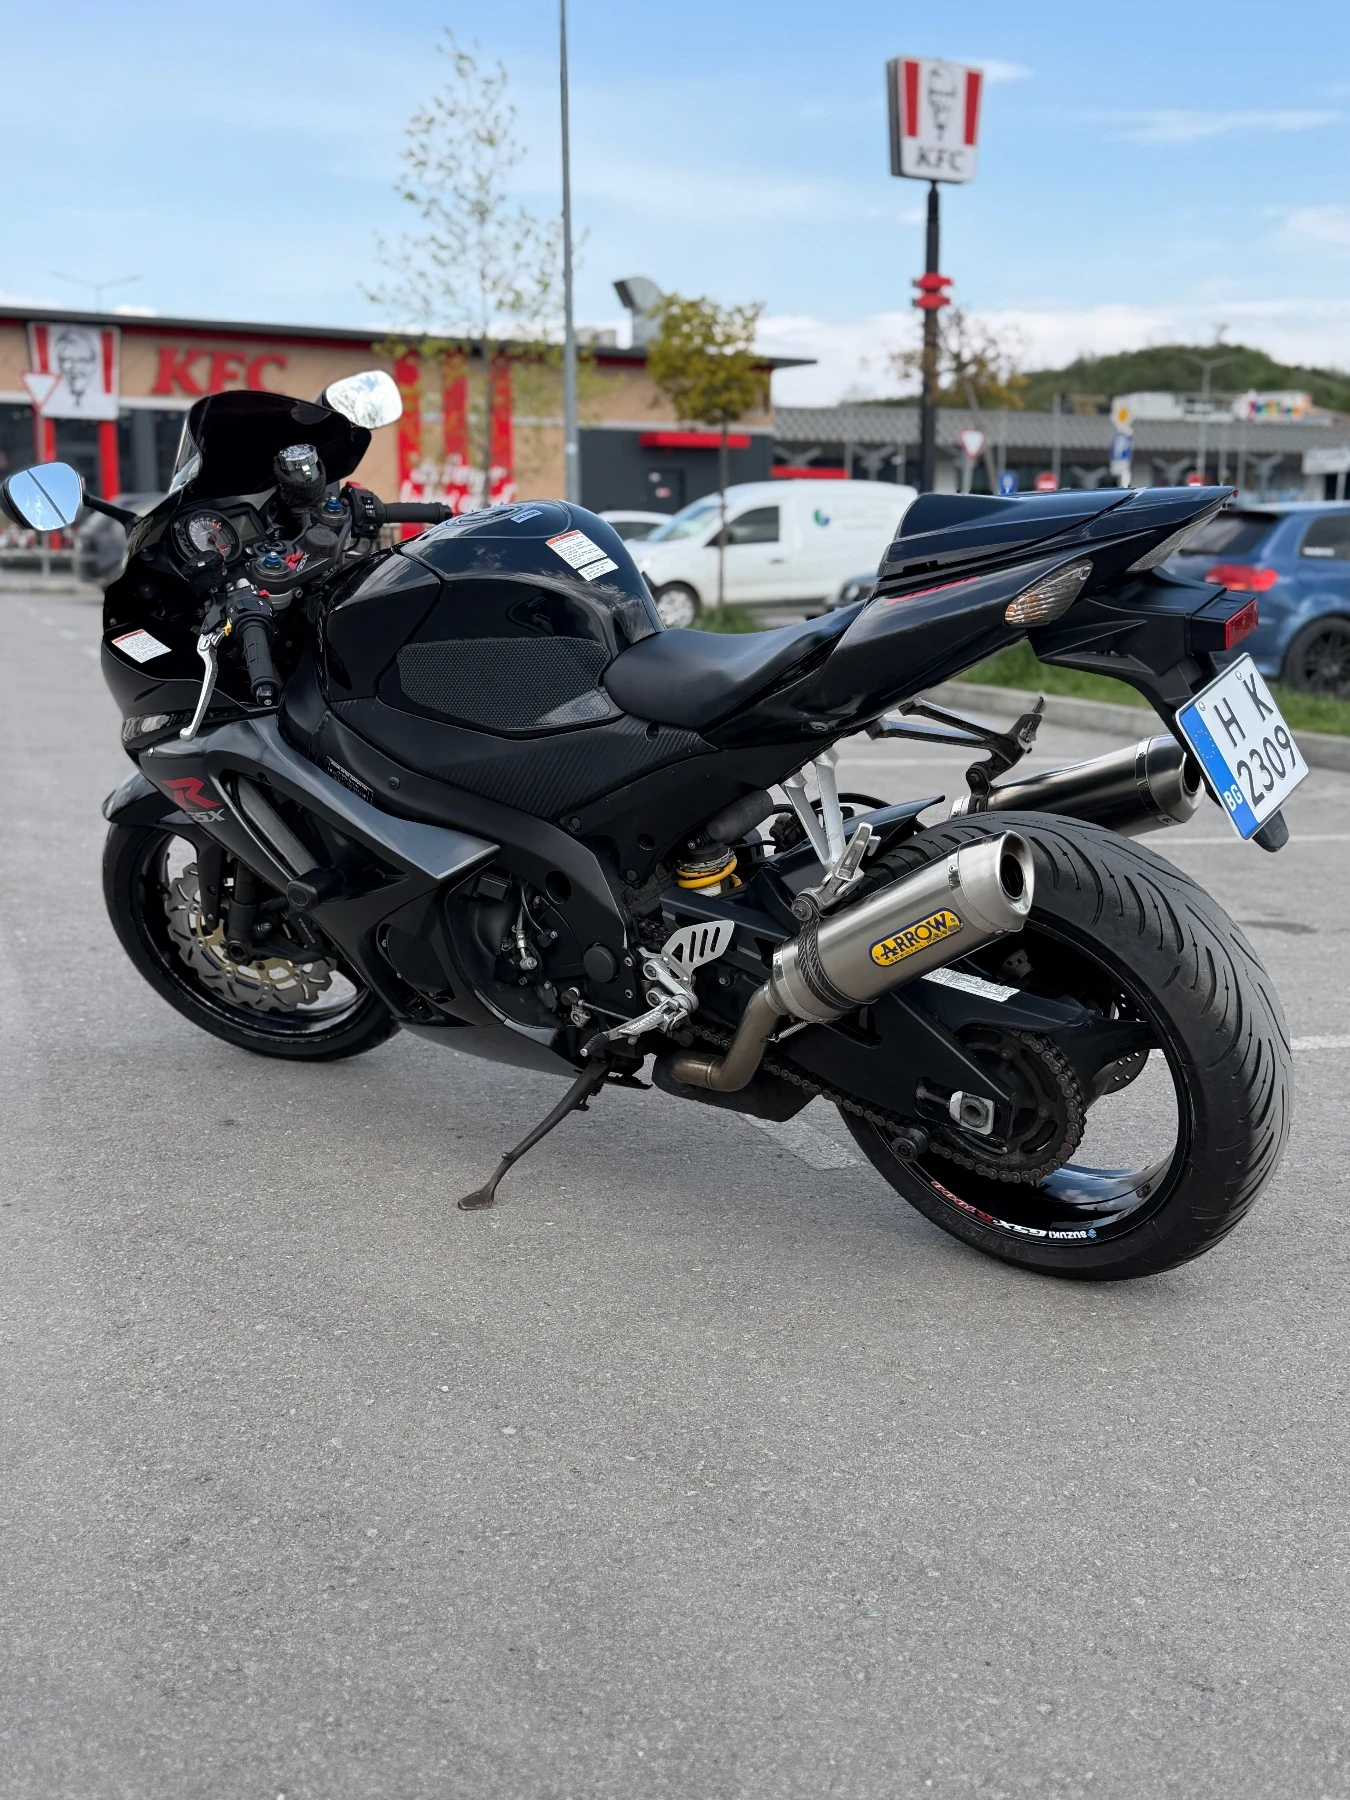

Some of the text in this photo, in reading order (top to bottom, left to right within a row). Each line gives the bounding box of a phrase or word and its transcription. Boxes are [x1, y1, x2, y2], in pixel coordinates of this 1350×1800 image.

[917, 146, 965, 172] KFC
[152, 346, 287, 396] KFC
[1213, 673, 1274, 748] H K
[1236, 724, 1296, 809] 2309
[1223, 784, 1244, 812] BG
[880, 912, 949, 960] ARROW
[1048, 1230, 1088, 1239] SUZUKI
